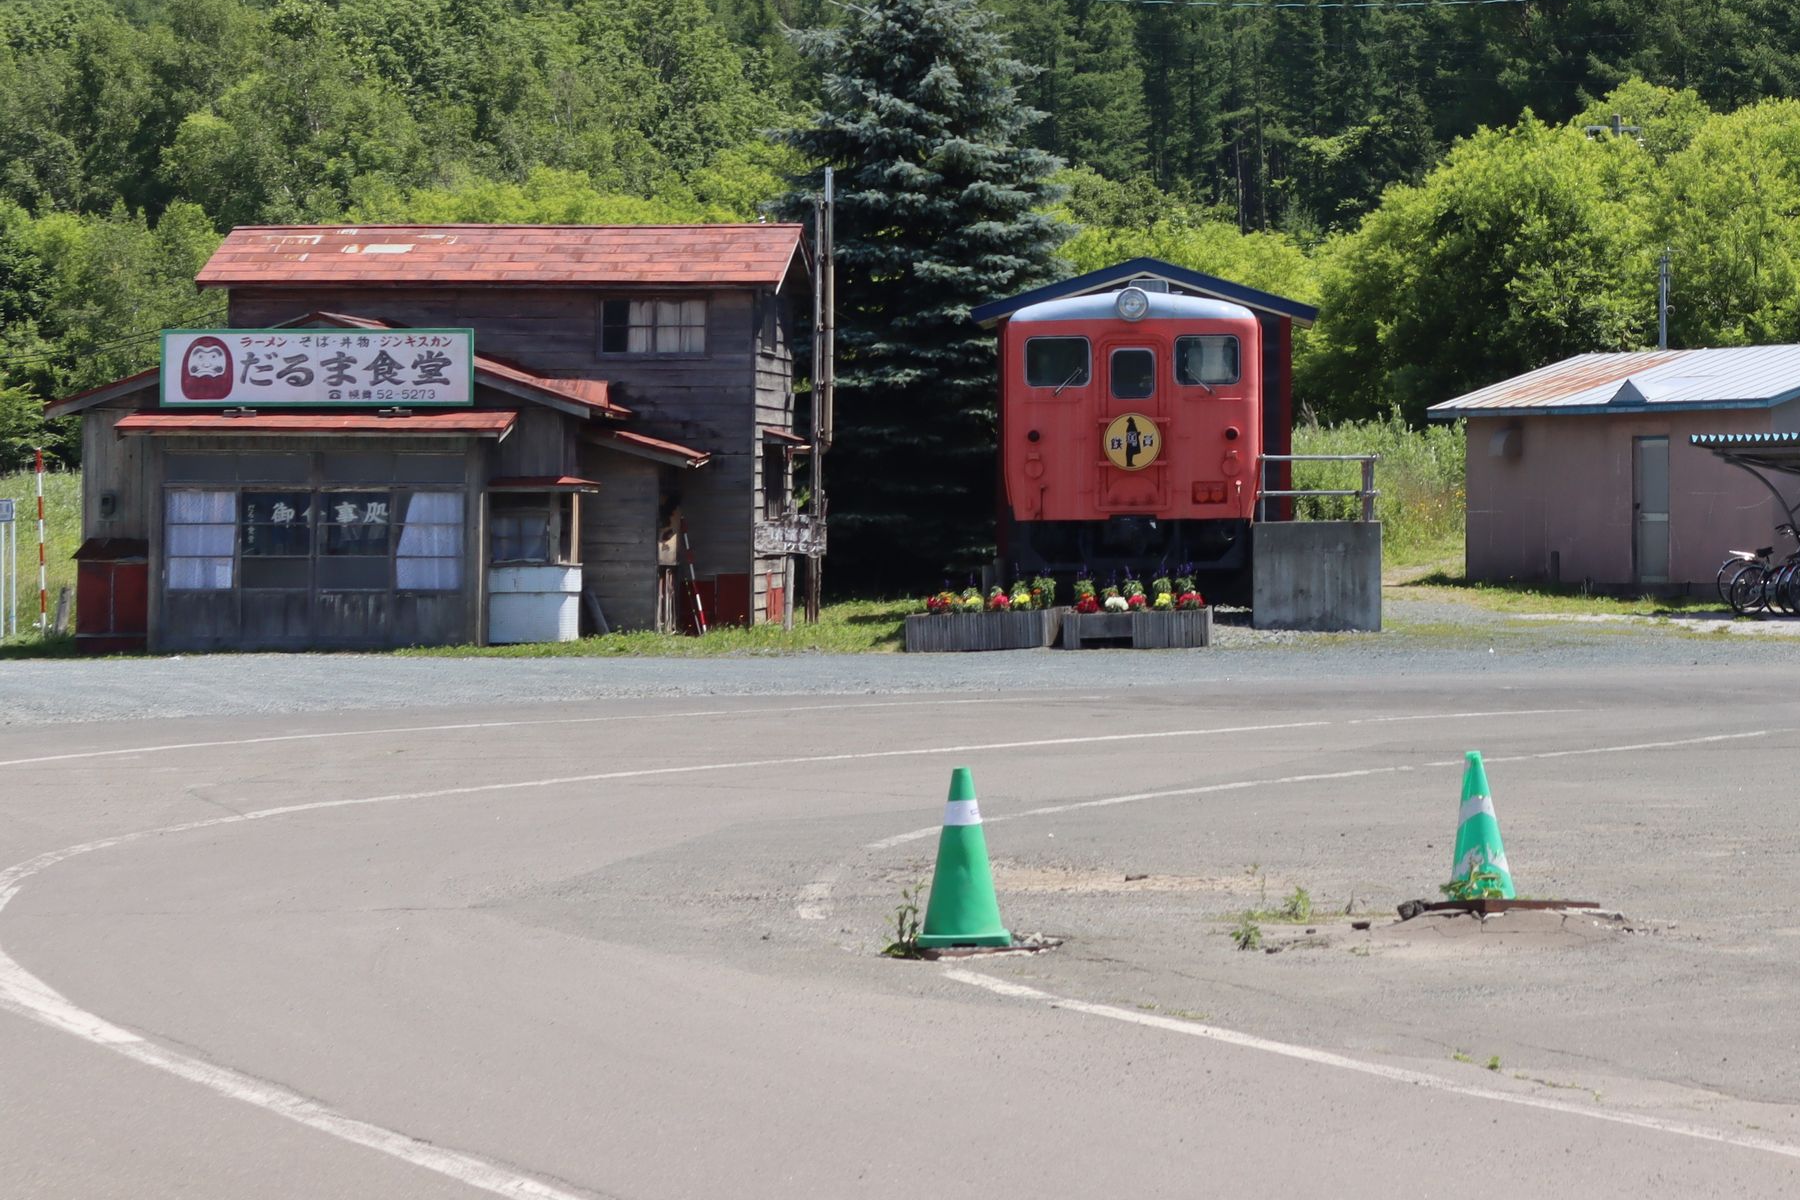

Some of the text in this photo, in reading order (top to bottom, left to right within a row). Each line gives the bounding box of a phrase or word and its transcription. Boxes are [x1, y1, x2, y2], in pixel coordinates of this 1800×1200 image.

[239, 350, 453, 387] だるま食堂
[376, 389, 436, 400] 52-5273
